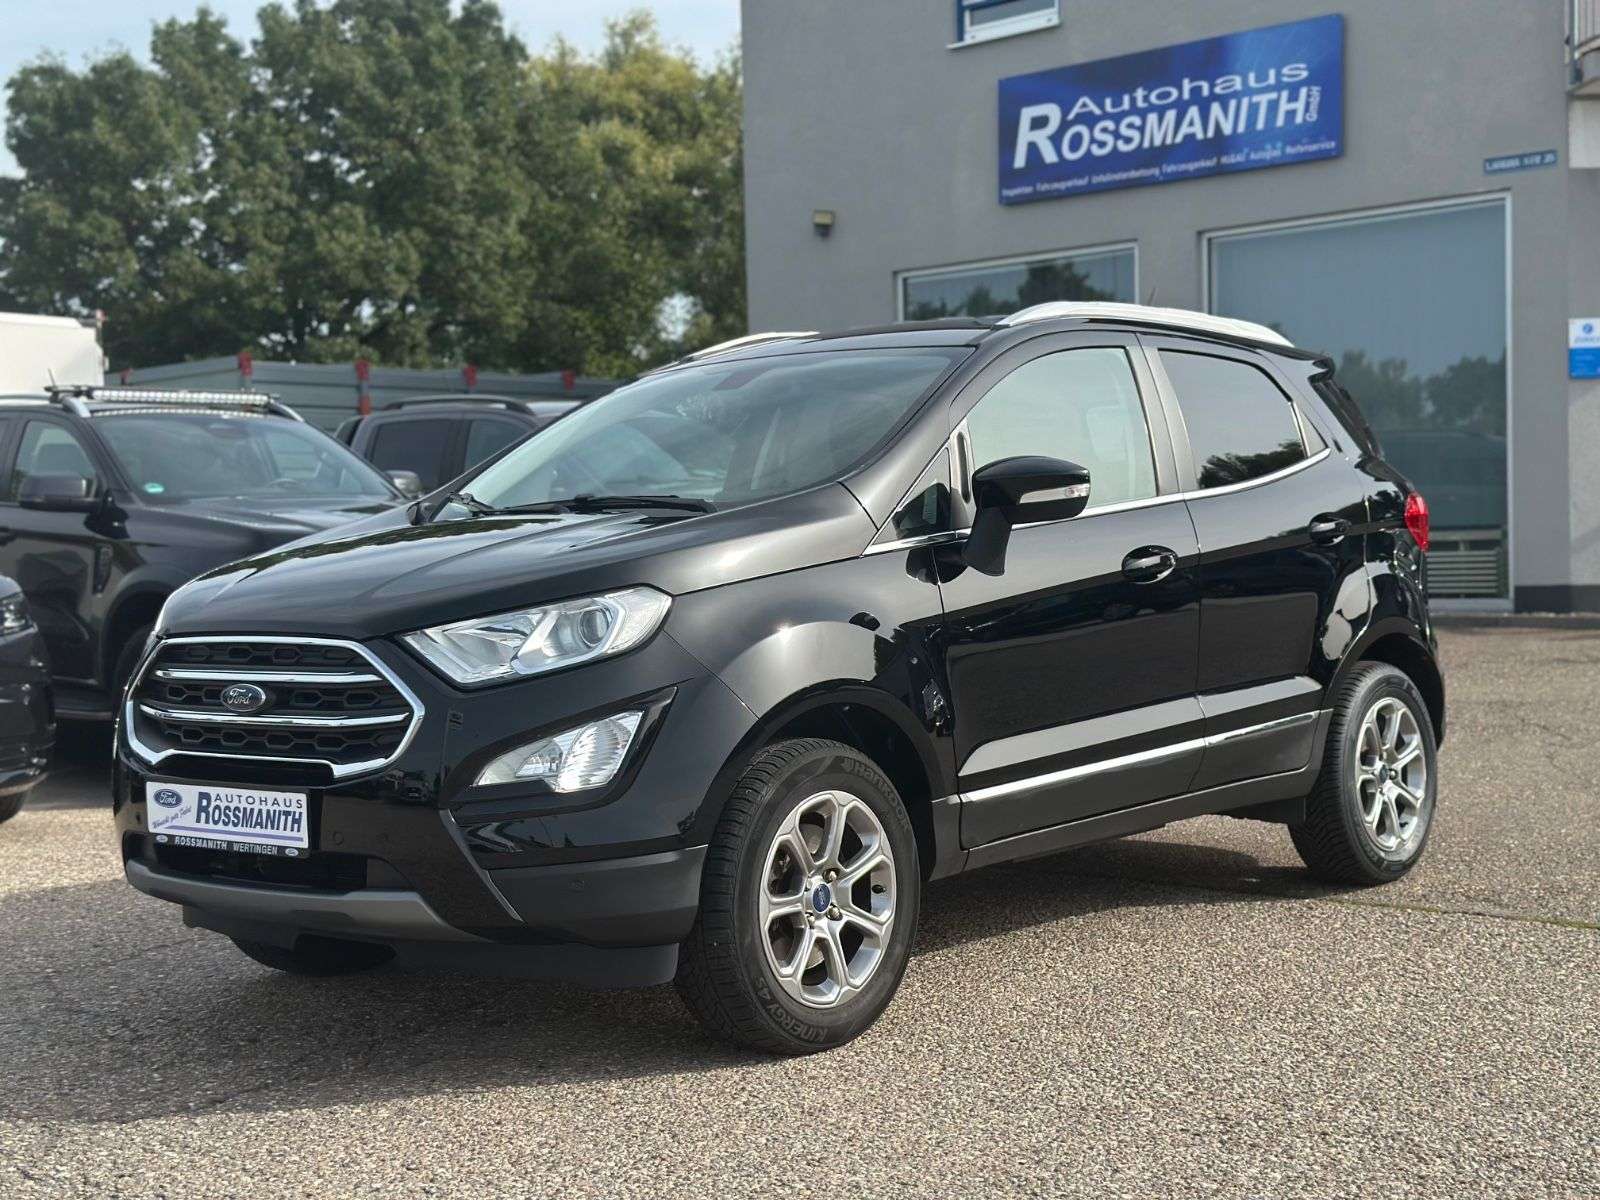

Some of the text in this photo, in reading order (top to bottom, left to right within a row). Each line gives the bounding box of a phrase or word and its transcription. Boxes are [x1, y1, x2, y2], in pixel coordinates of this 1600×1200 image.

[1067, 63, 1309, 120] Autohaus
[1305, 85, 1322, 122] GmbH
[1013, 88, 1308, 169] ROSSMANITH
[195, 791, 303, 833] ROSSMANITH
[213, 793, 303, 809] AUTOHAUS
[174, 836, 228, 850] ROSSMANITH
[232, 842, 278, 855] WERTINGEN
